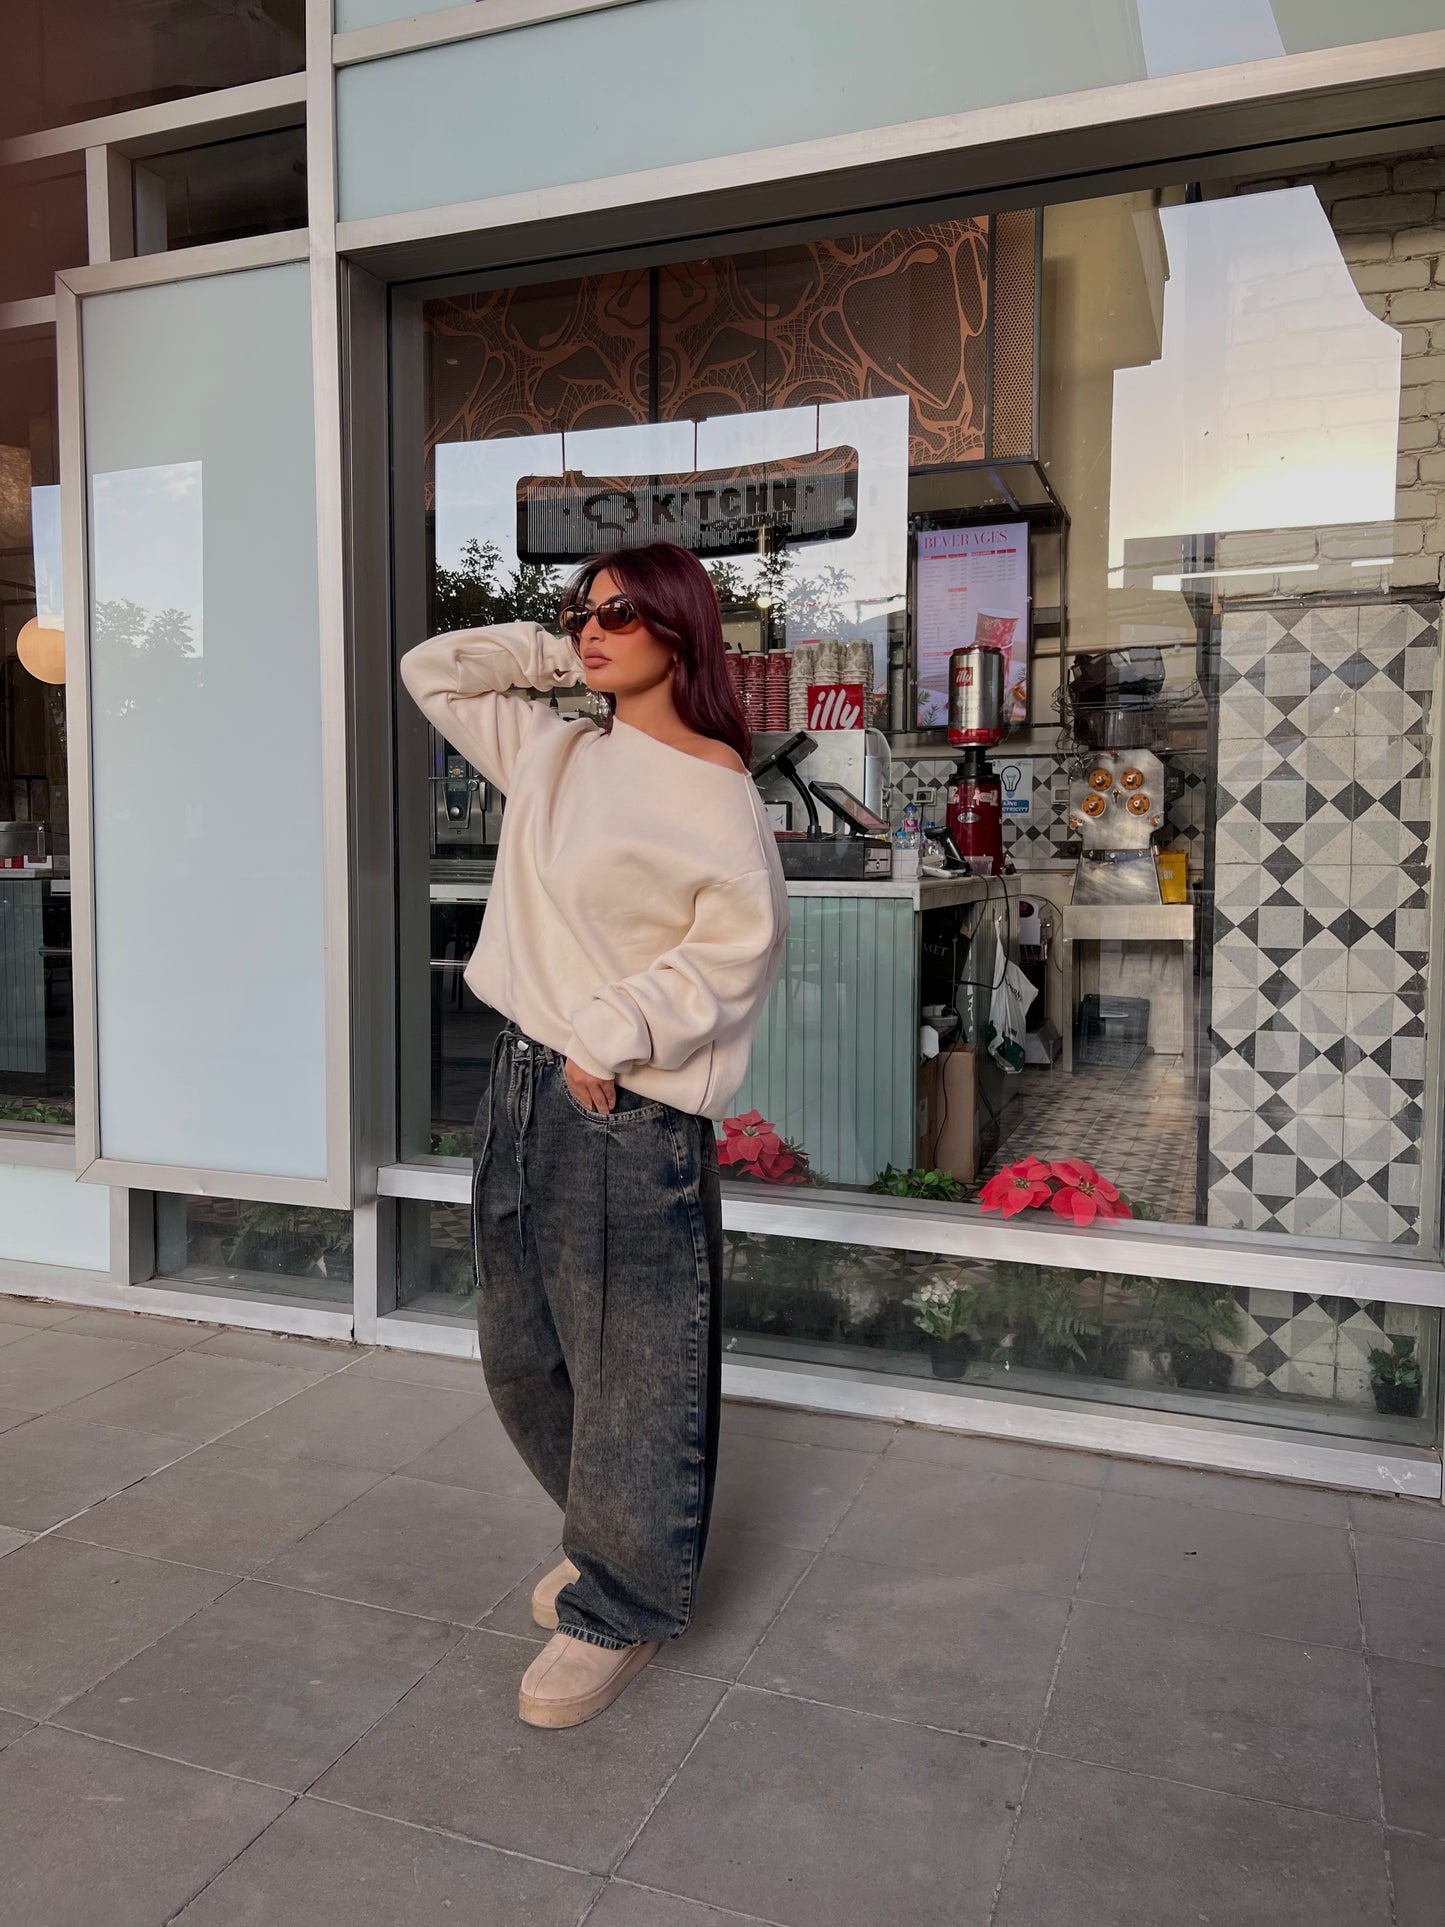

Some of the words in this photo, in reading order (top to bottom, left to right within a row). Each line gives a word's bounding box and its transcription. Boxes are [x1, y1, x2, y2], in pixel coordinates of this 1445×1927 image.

[924, 531, 1008, 549] BEVERAGES
[956, 670, 972, 683] illy
[810, 689, 861, 730] illy
